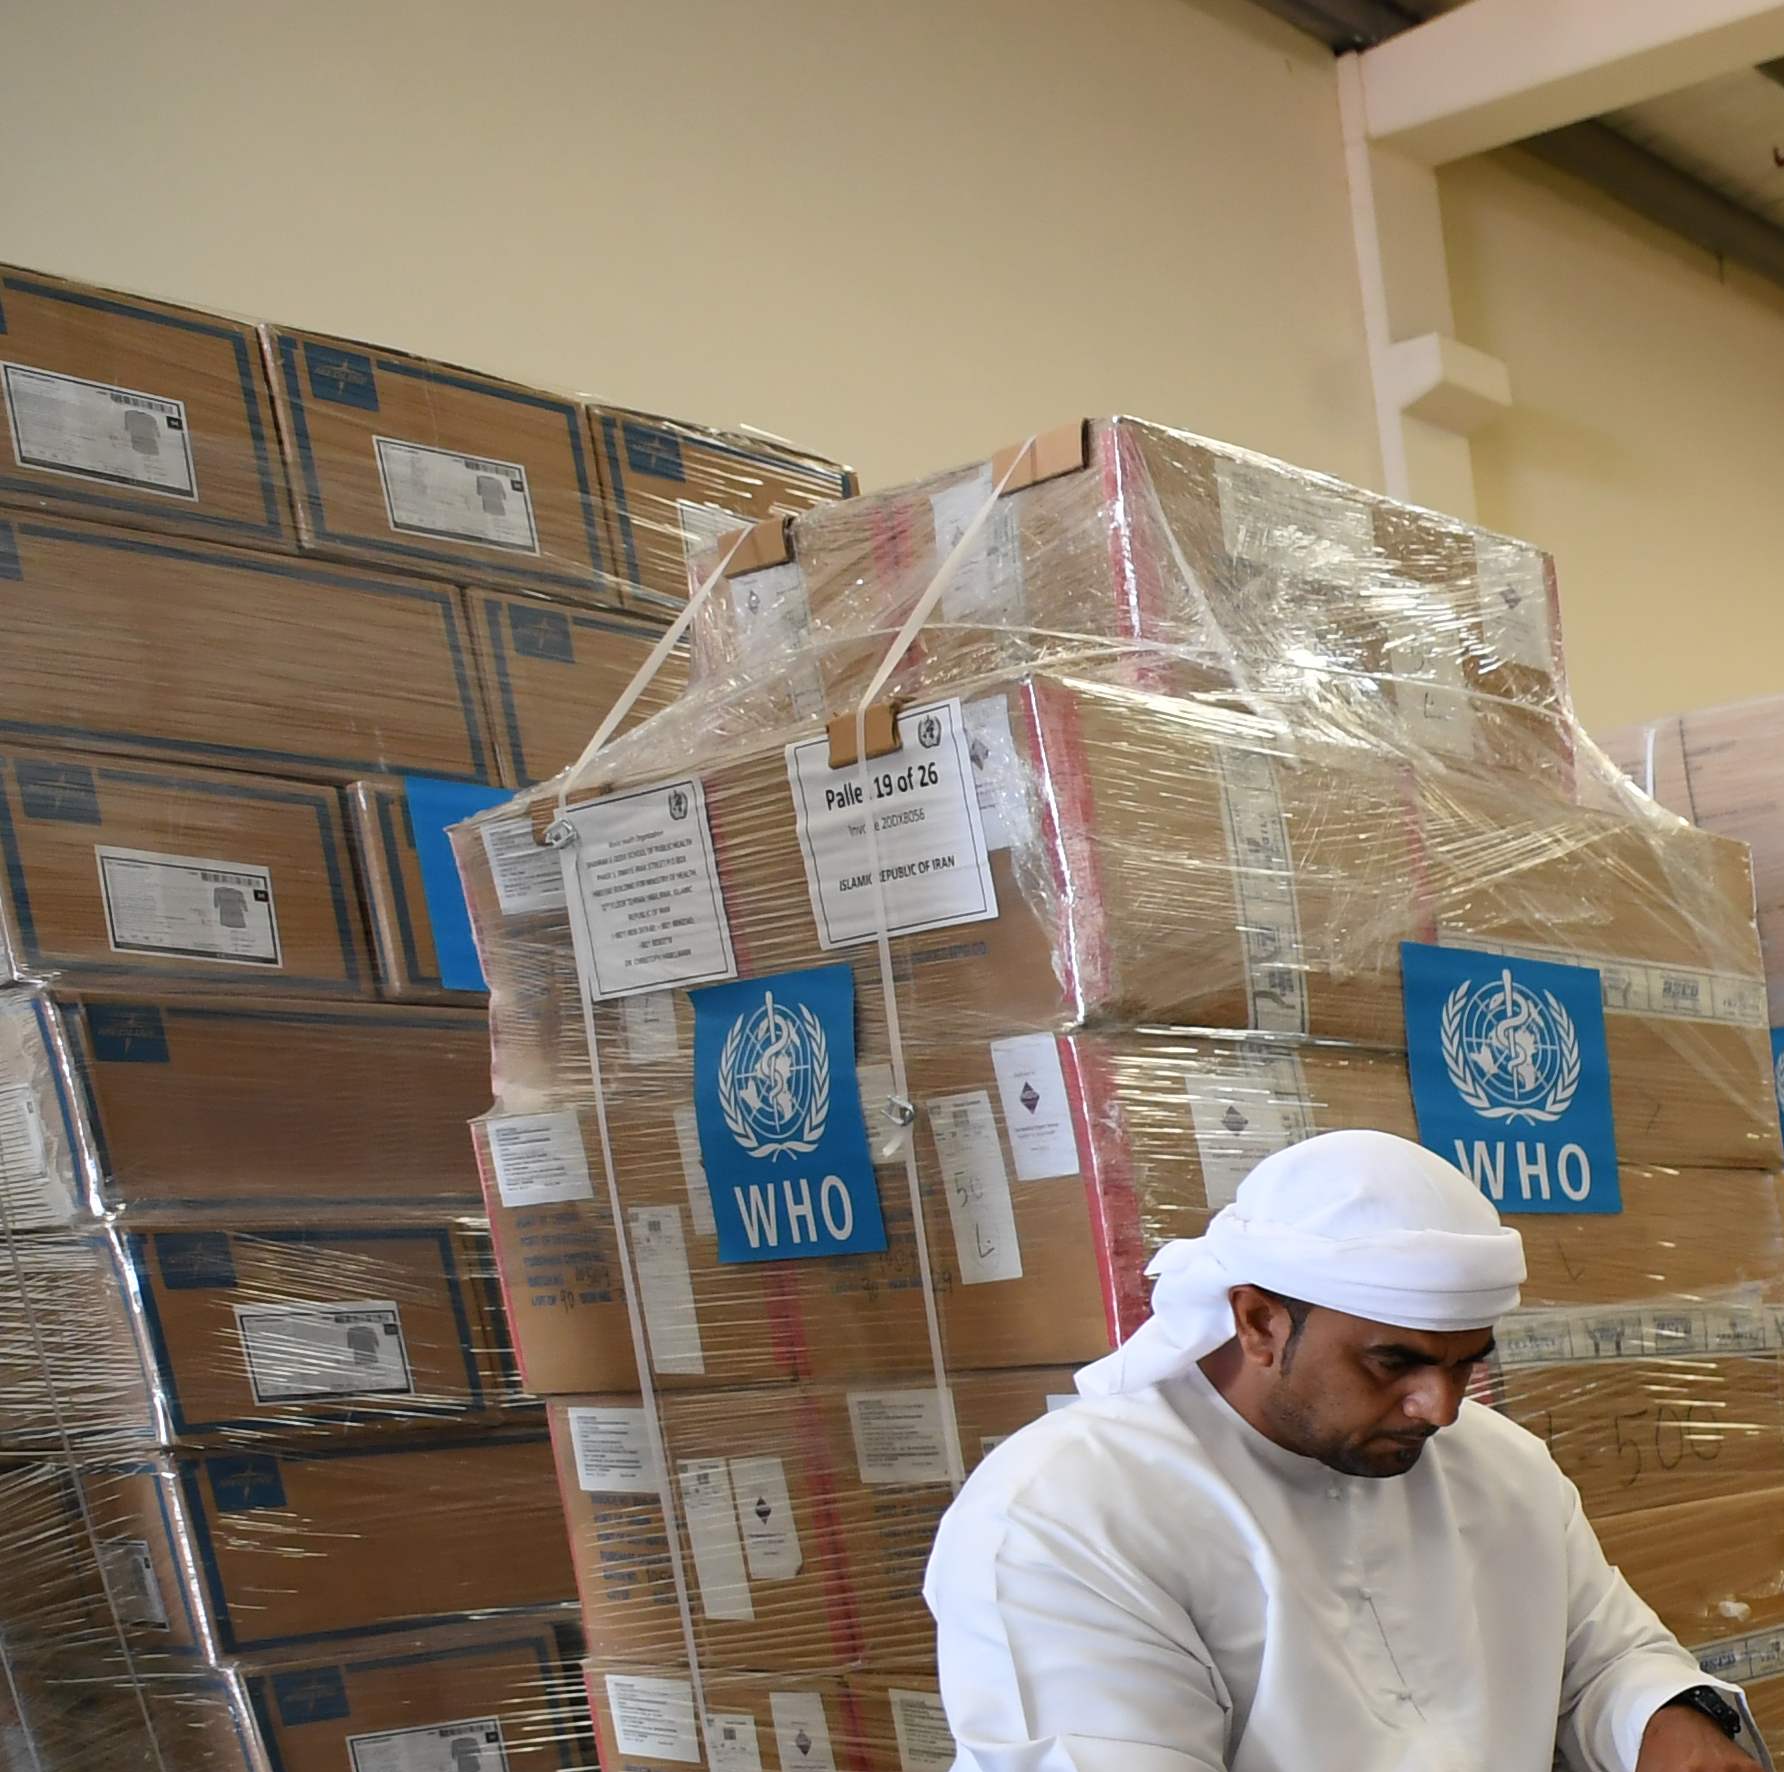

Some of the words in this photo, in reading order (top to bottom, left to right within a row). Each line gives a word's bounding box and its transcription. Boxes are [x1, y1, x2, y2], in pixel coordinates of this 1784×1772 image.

[825, 781, 864, 811] Palle
[873, 774, 893, 799] 19
[897, 766, 914, 793] of
[917, 761, 939, 788] 26
[931, 855, 956, 872] IRAN
[1454, 1139, 1592, 1202] WHO
[733, 1174, 854, 1250] WHO
